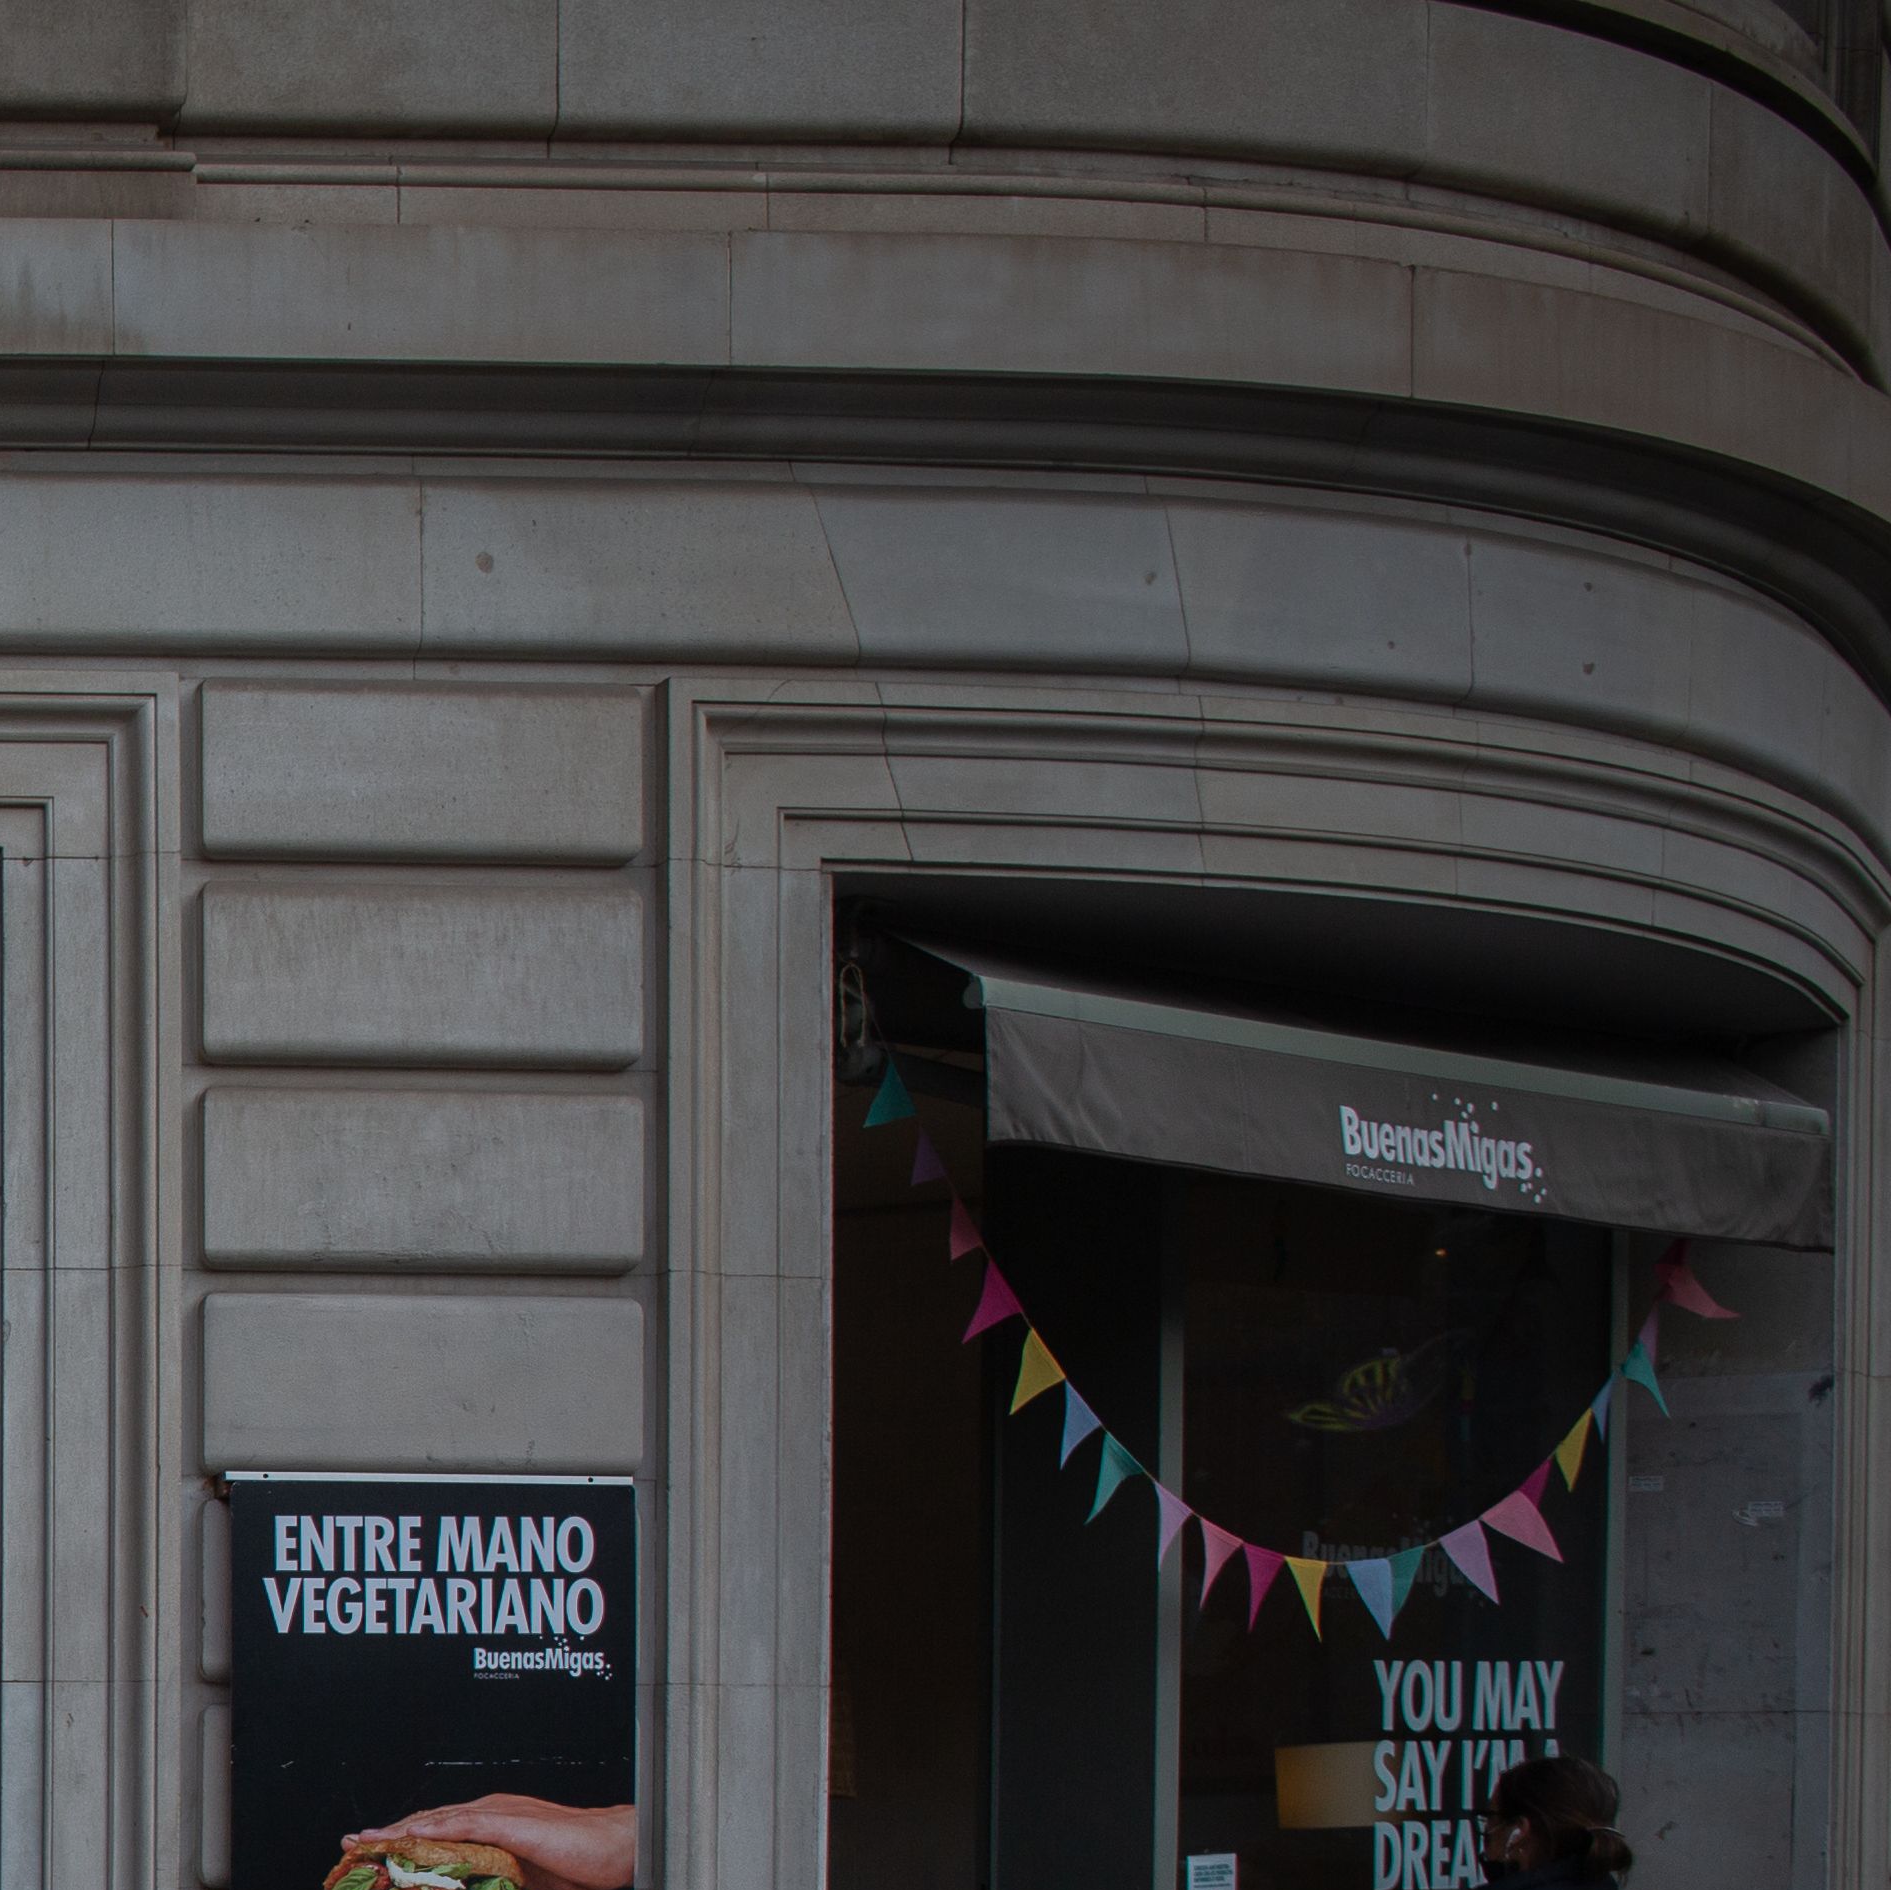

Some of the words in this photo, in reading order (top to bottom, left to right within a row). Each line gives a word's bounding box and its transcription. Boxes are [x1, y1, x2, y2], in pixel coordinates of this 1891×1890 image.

[1338, 1105, 1533, 1190] BuenasMigas
[1345, 1163, 1416, 1186] FOCACCERIA
[274, 1515, 423, 1573] ENTRE
[436, 1515, 596, 1573] MANO
[262, 1577, 606, 1635] VEGETARIANO
[472, 1645, 605, 1677] BuenasMigas
[1372, 1659, 1463, 1733] YOU
[1471, 1659, 1565, 1732] MAY
[1373, 1739, 1453, 1813] SAY
